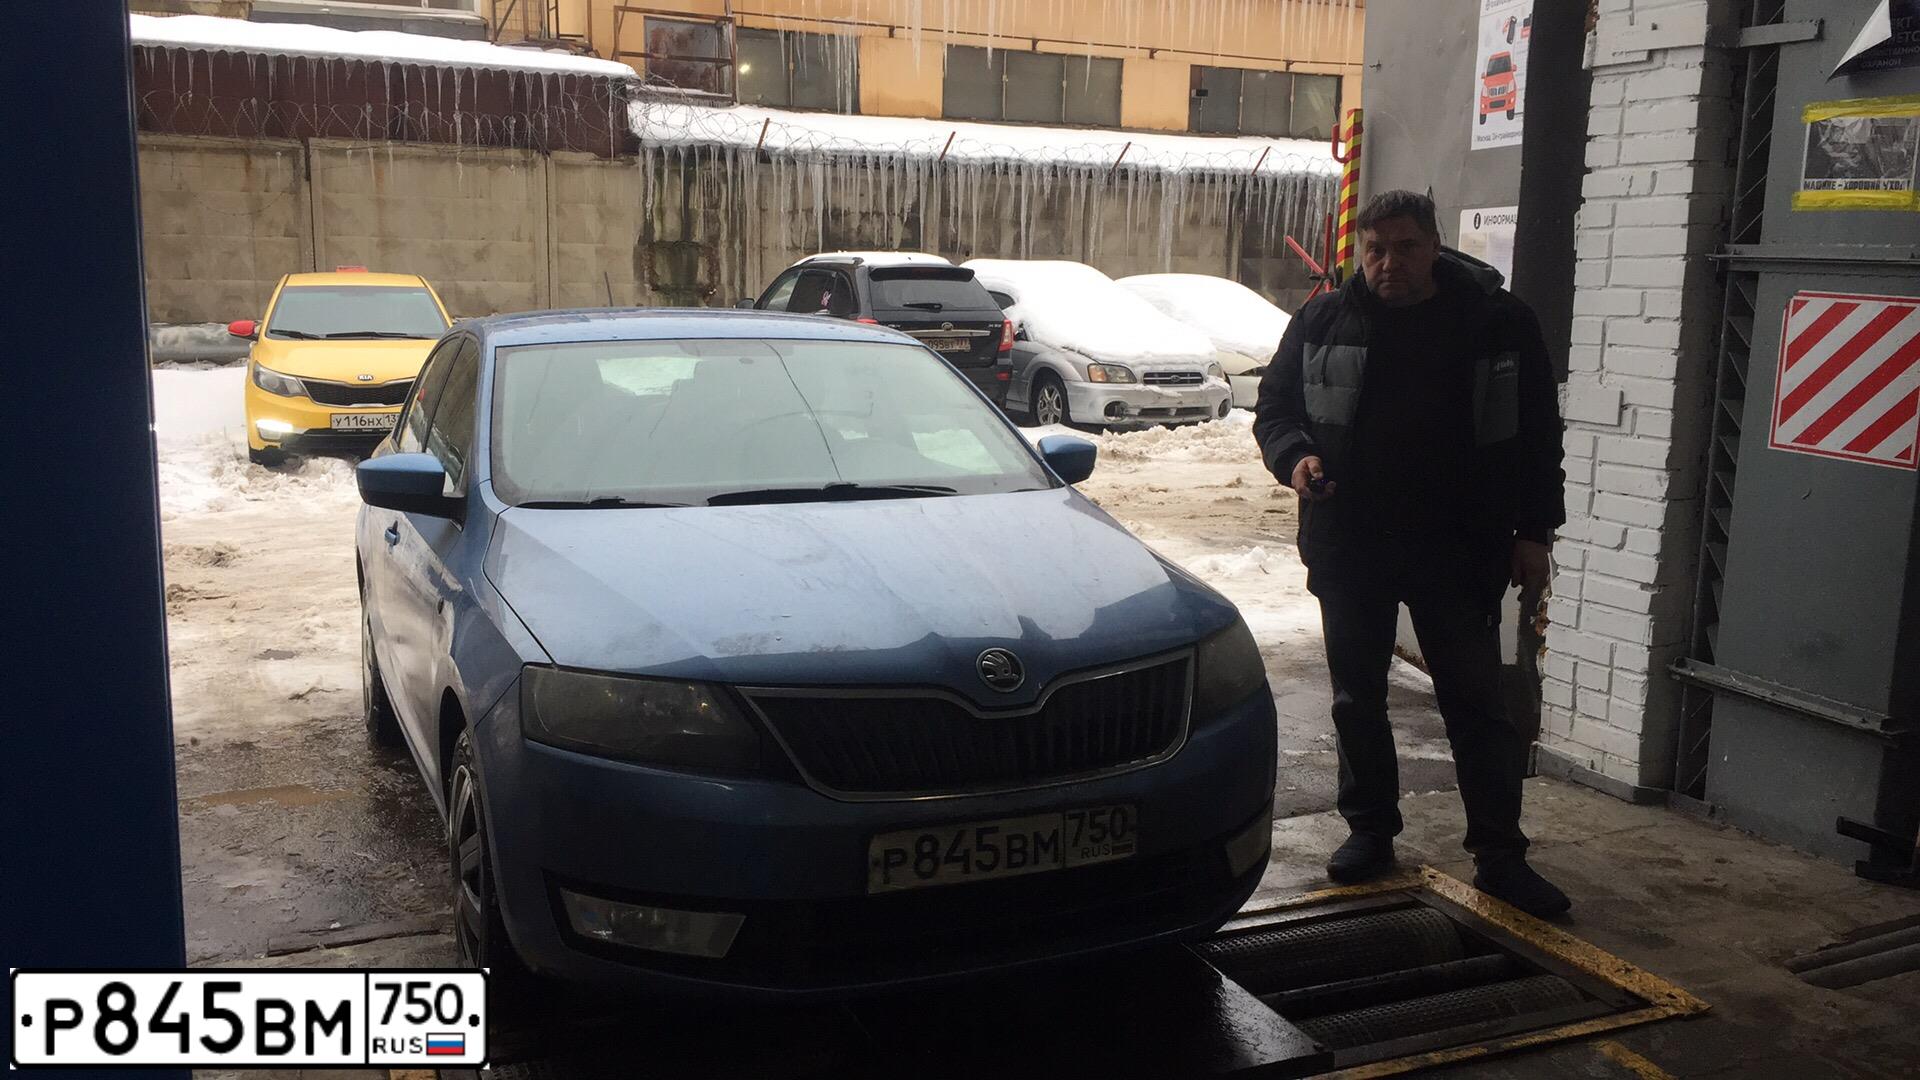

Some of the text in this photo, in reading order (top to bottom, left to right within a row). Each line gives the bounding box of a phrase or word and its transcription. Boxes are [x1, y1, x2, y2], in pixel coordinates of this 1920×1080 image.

[883, 806, 1129, 884] Р845ВМ 750
[1080, 844, 1111, 860] RUS
